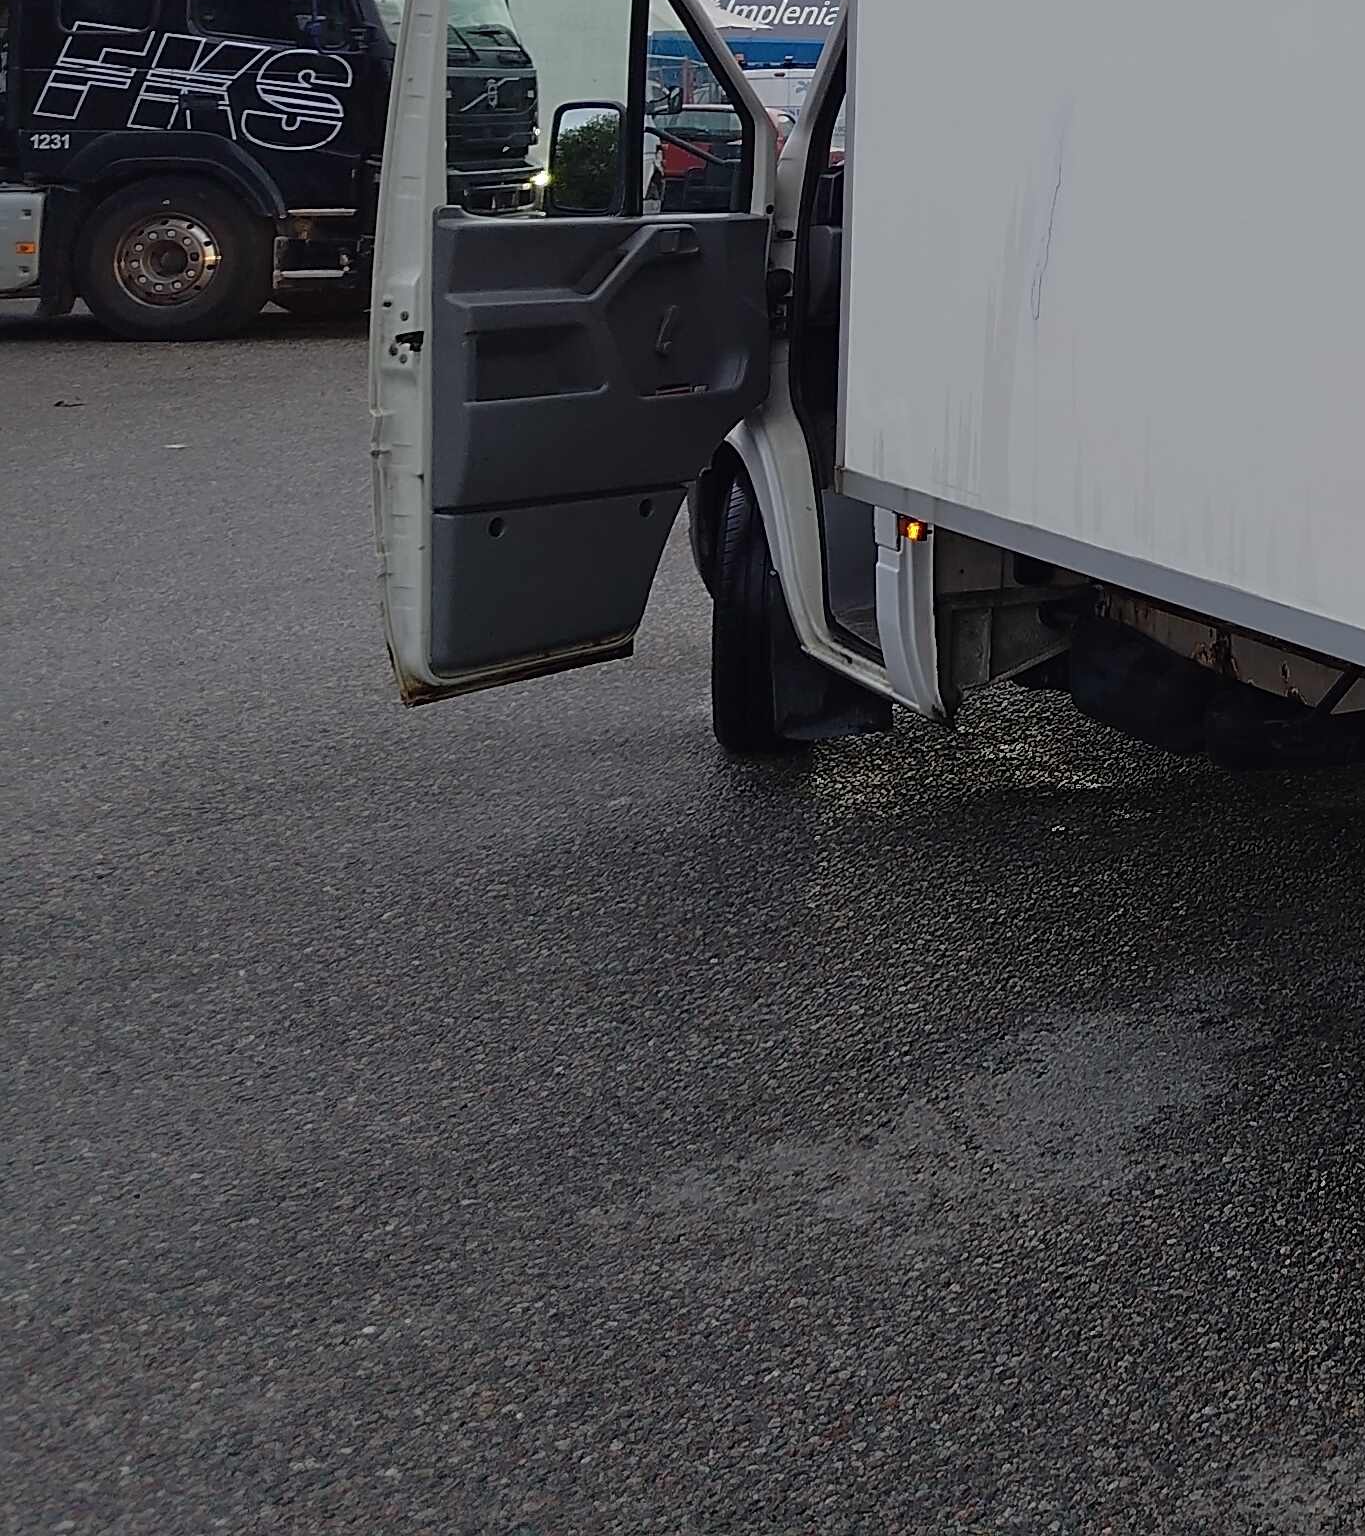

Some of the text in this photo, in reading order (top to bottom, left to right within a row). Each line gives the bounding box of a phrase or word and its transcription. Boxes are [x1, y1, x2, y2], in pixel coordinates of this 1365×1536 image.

[725, 0, 839, 26] Implenia
[33, 20, 352, 151] FKS
[30, 133, 70, 150] 1231
